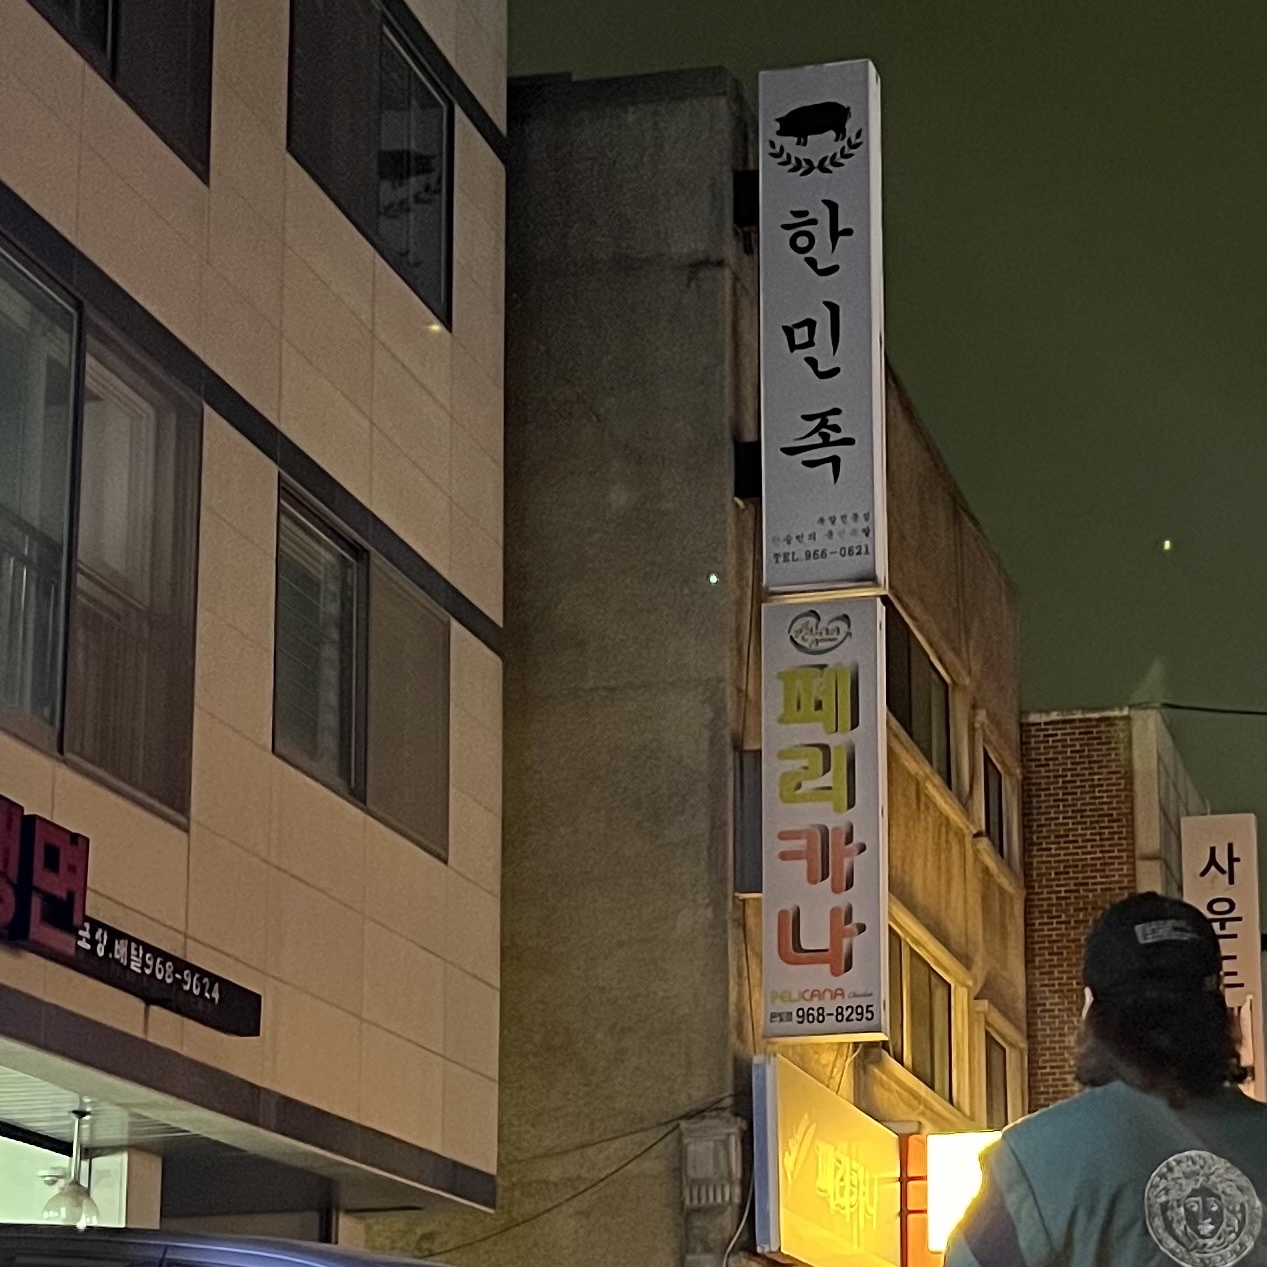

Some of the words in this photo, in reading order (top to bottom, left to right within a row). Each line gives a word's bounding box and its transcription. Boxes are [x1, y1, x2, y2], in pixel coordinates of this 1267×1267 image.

[780, 199, 856, 485] 한민족
[777, 664, 867, 978] 페리카나
[770, 988, 845, 1003] PELICANA
[796, 1004, 875, 1025] 968-8295
